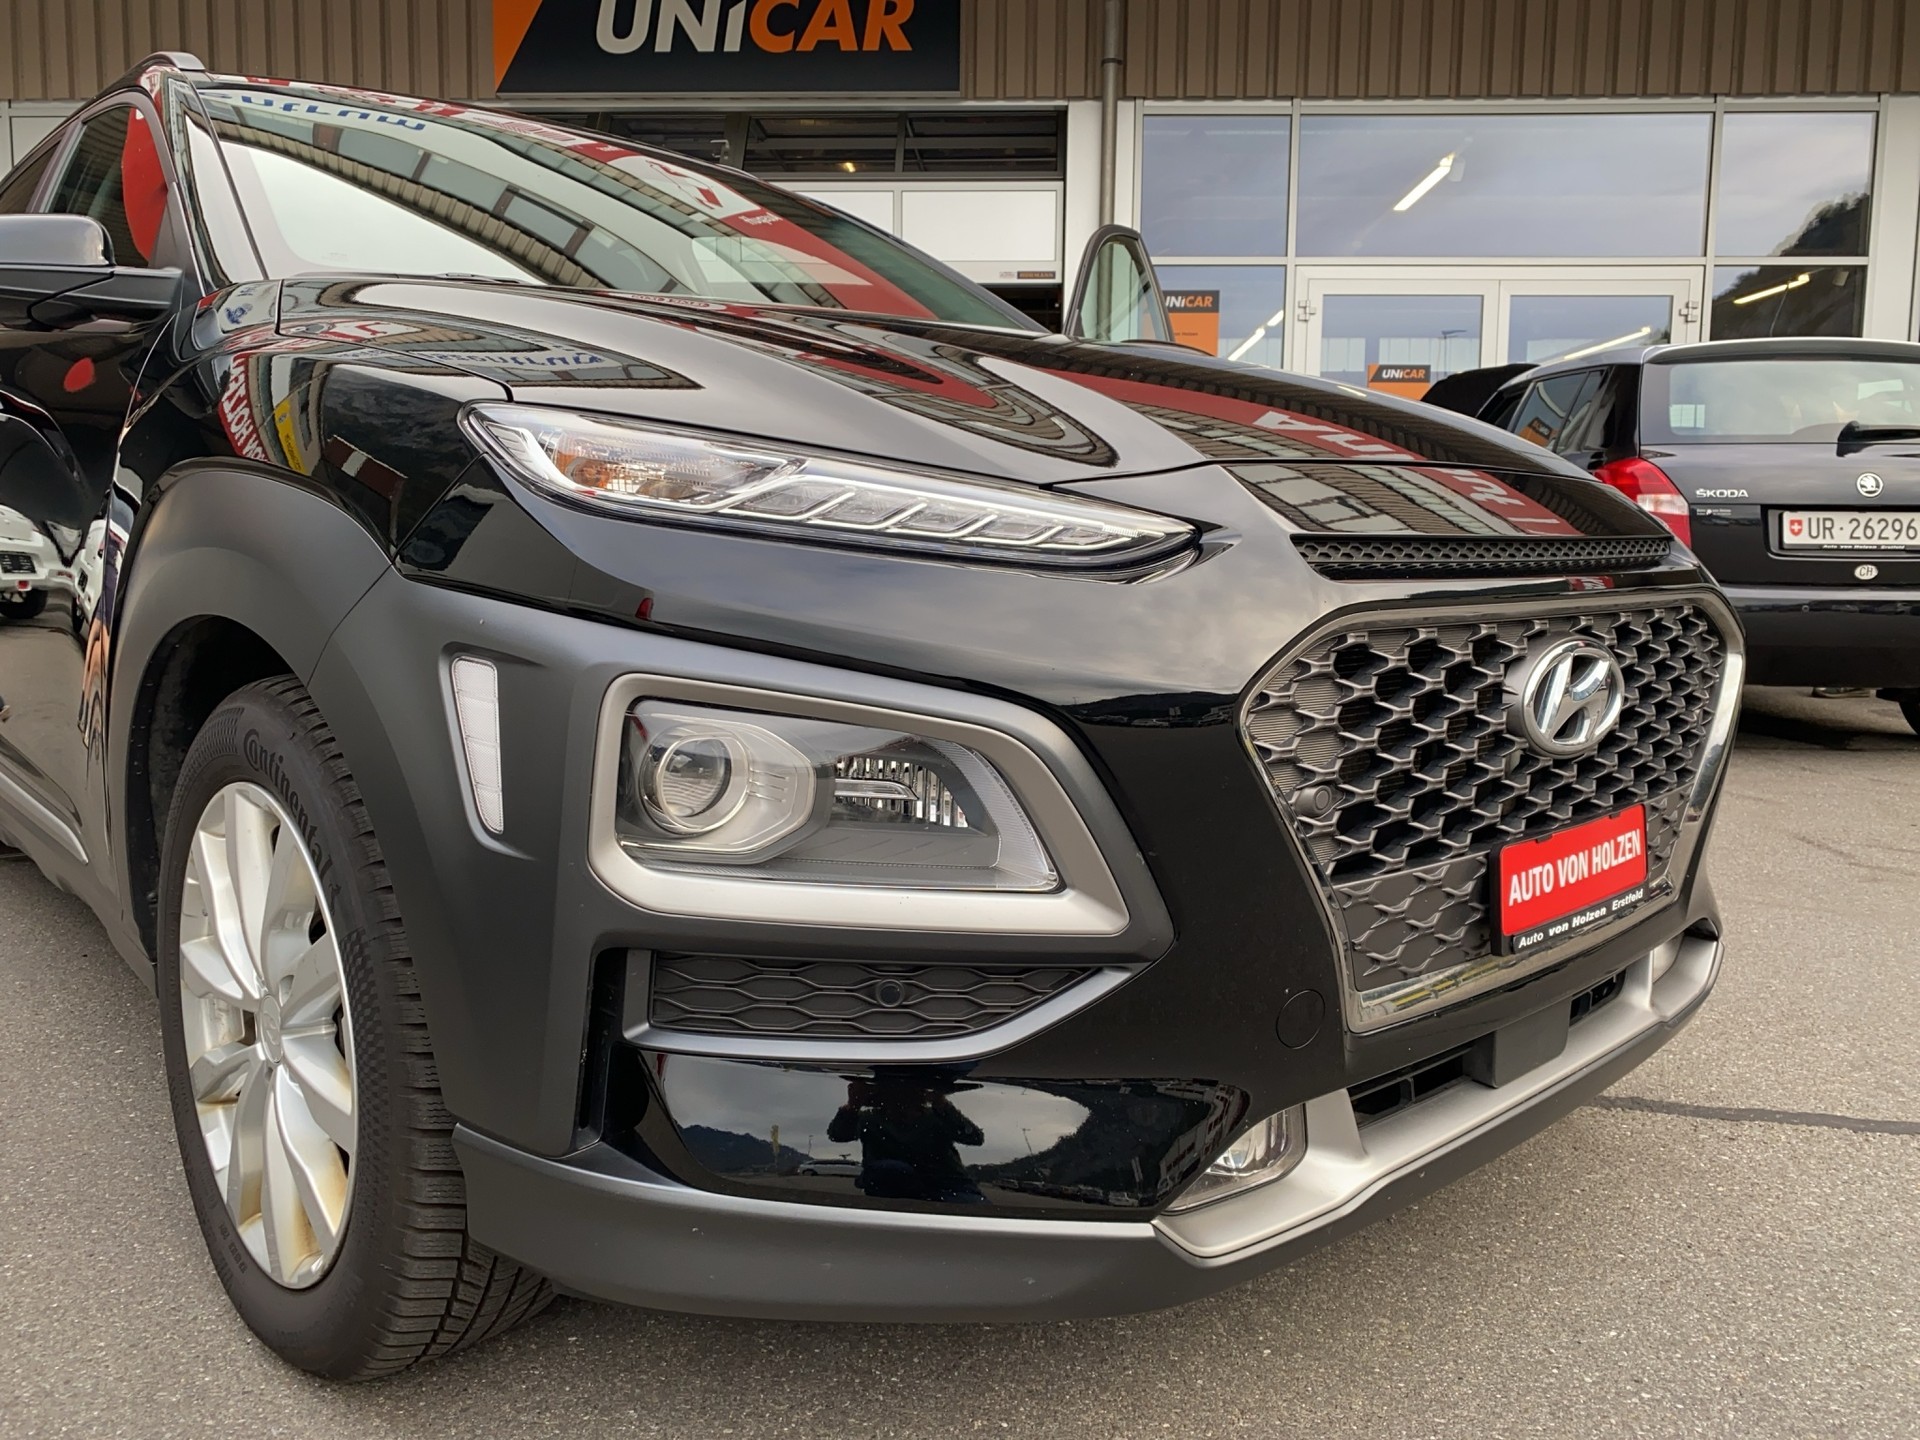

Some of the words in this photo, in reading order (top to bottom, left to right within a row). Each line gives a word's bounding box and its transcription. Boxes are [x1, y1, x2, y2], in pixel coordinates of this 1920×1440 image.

[1696, 487, 1749, 498] ŠKODA
[1808, 517, 1835, 540] UR
[1848, 517, 1918, 541] 26296
[1859, 566, 1874, 577] CH
[243, 728, 333, 883] Continental
[1508, 862, 1555, 907] AUTO
[1556, 849, 1589, 888] VON
[1591, 828, 1642, 876] HOLZEN
[1518, 932, 1544, 949] Auto
[1548, 922, 1570, 937] von
[1571, 906, 1607, 928] Holzen
[1611, 888, 1645, 912] Erstfeld
